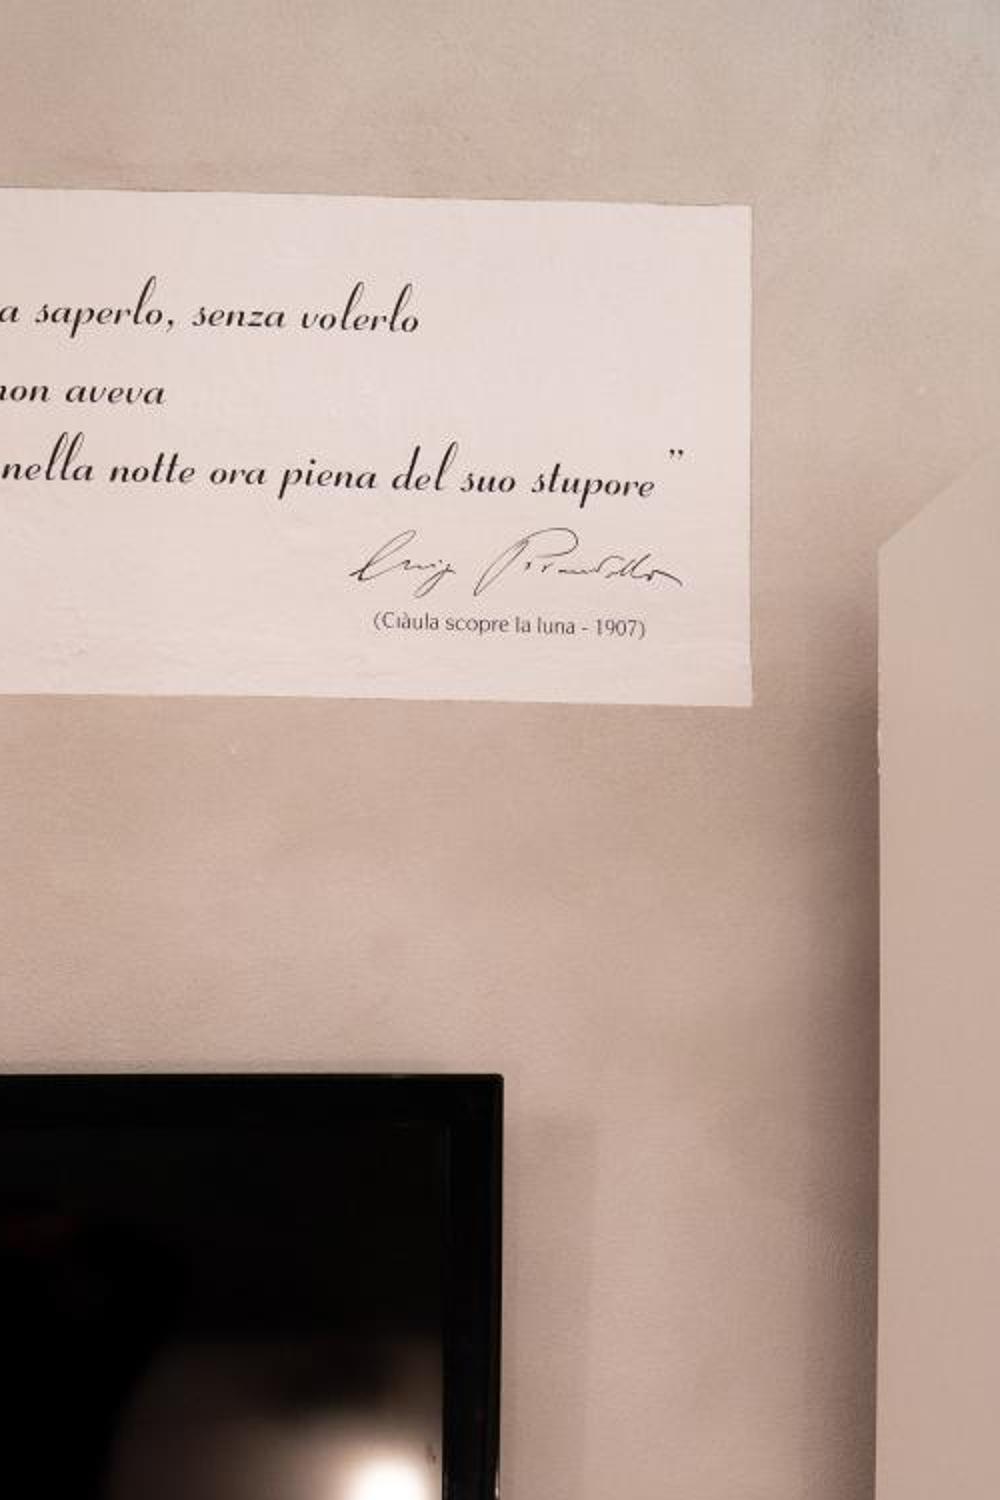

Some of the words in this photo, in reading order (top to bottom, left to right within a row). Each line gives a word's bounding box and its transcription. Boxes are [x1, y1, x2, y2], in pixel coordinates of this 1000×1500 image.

[34, 275, 174, 339] saperlo,
[191, 306, 285, 328] senza
[301, 281, 419, 333] volerlo
[65, 385, 165, 405] aveva
[1, 431, 93, 482] nella
[109, 452, 196, 484] notte
[209, 468, 266, 485] ora
[277, 458, 377, 501] piena
[391, 441, 457, 492] del
[459, 472, 516, 493] suo
[373, 611, 439, 631] (Ciàula
[445, 618, 510, 635] scopre
[515, 616, 531, 633] la
[537, 617, 575, 635] luna
[596, 619, 646, 638] 1907)
